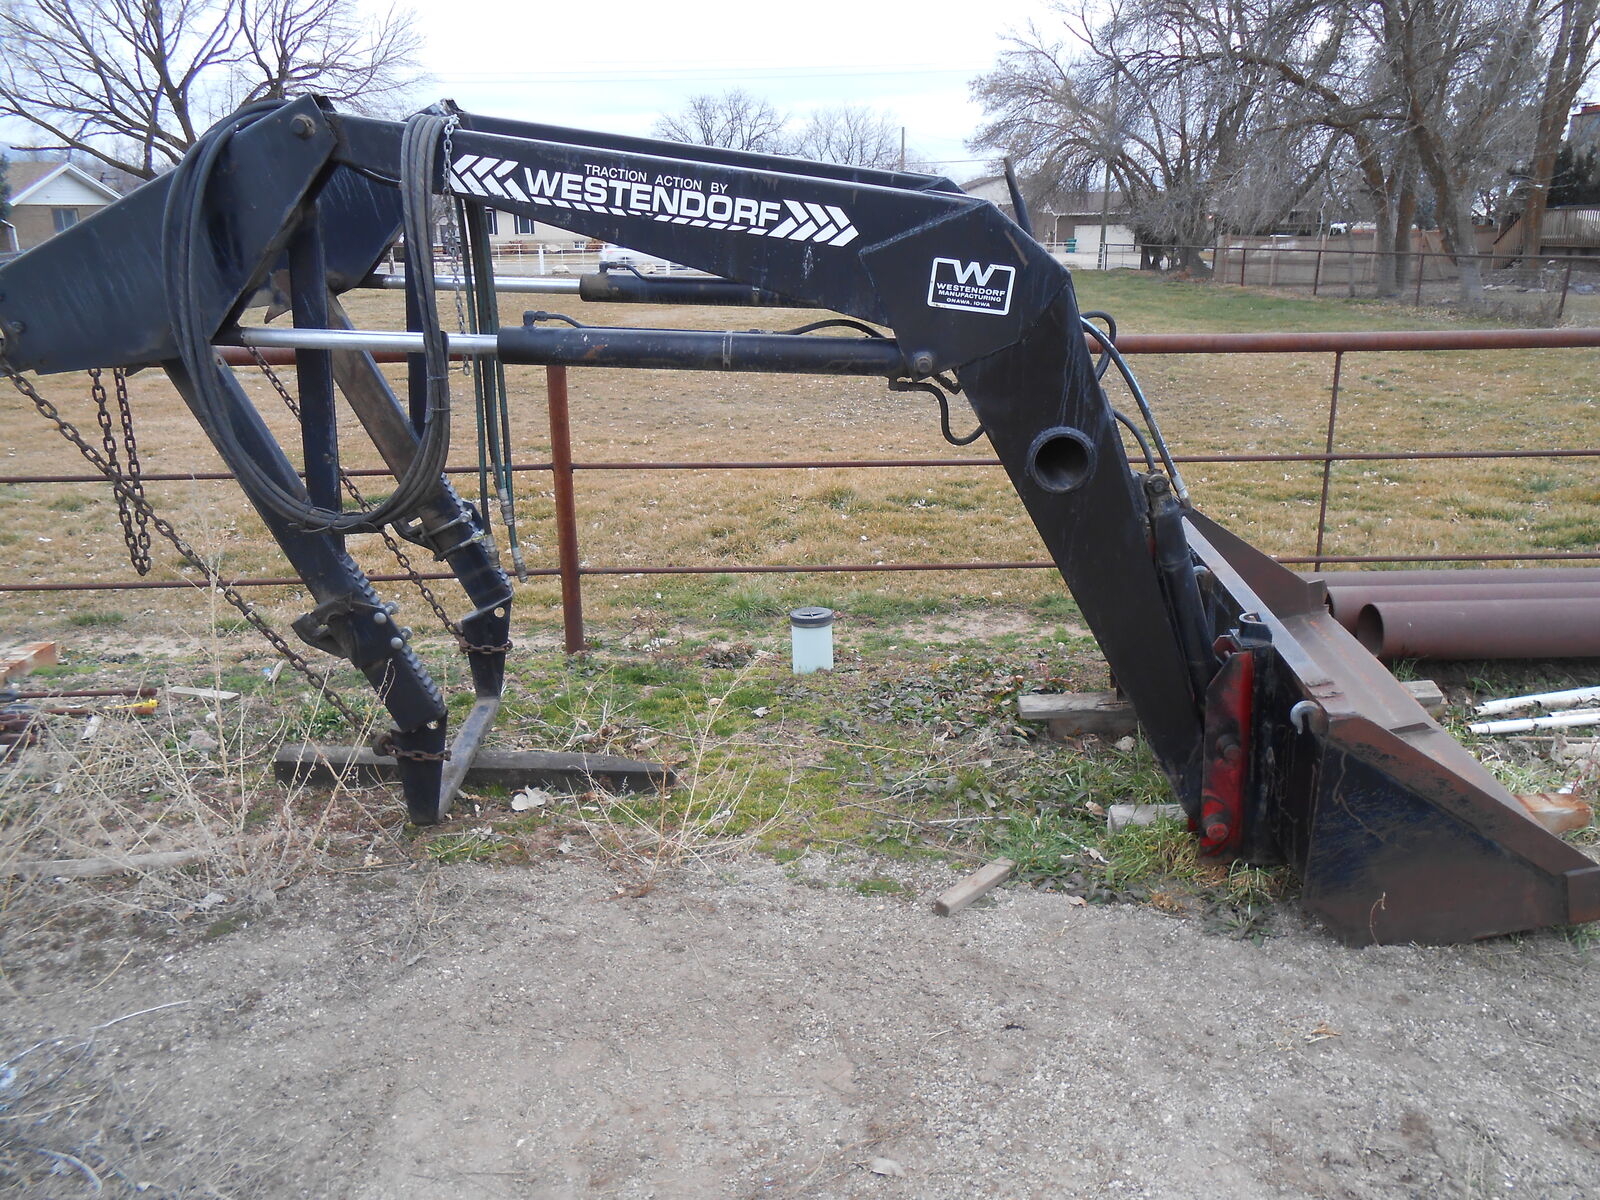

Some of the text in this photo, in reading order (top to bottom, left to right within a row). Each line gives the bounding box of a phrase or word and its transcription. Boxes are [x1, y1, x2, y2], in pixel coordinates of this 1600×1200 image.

[584, 164, 729, 194] TRACTION ACTION BY
[524, 167, 781, 226] WESTENDORF
[937, 283, 1005, 296] WESTENDORF
[938, 290, 1001, 302] MANUFACTURING
